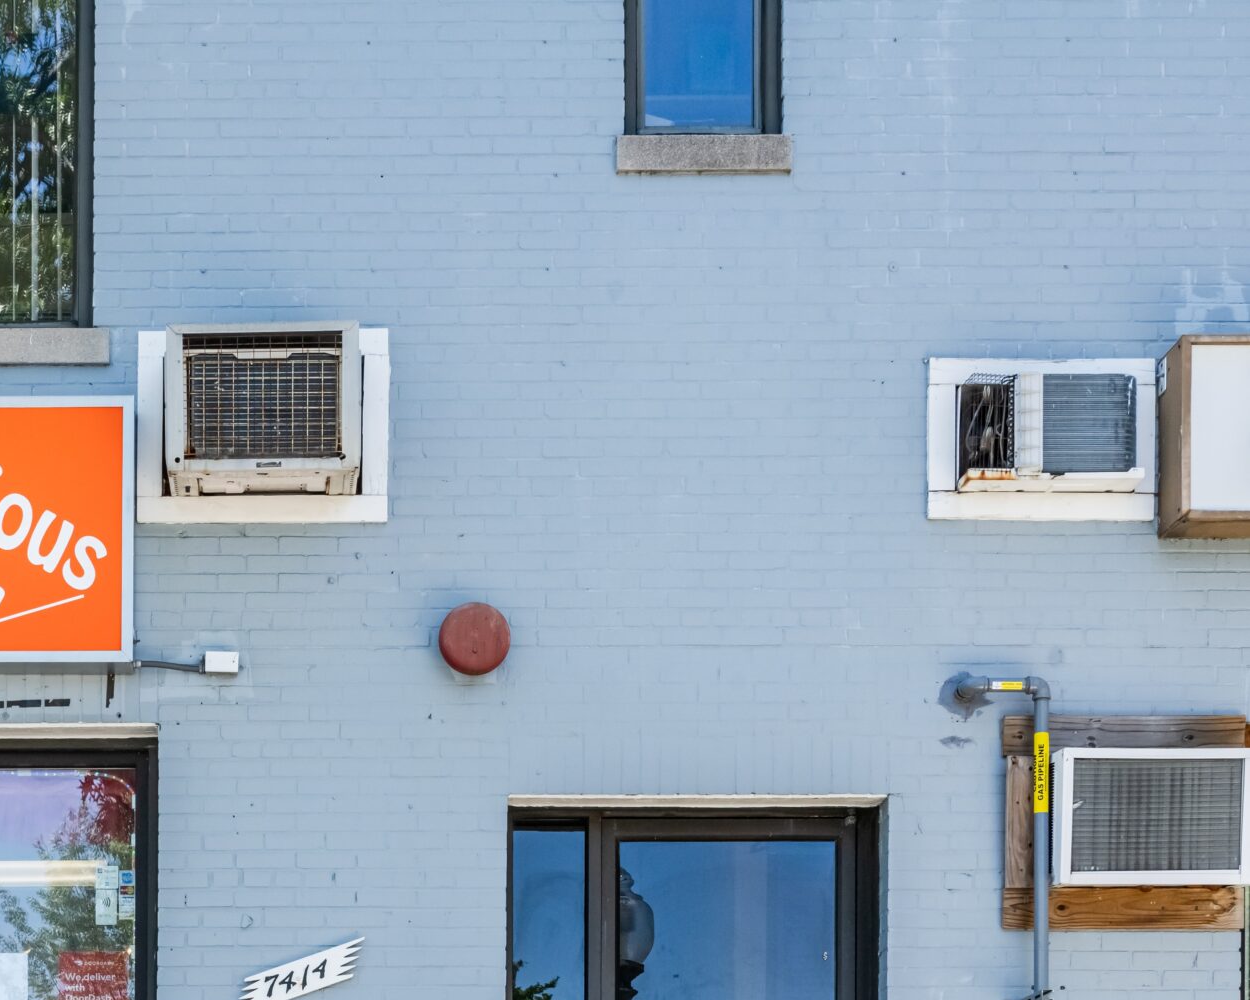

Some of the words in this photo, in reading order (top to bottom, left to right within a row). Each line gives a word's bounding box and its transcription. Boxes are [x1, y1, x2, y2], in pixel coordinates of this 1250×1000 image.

[1037, 743, 1045, 782] PIPELINE
[1037, 783, 1045, 801] GAS
[64, 972, 82, 981] We
[84, 972, 116, 982] deliver
[264, 958, 328, 998] 7414
[64, 983, 86, 992] with
